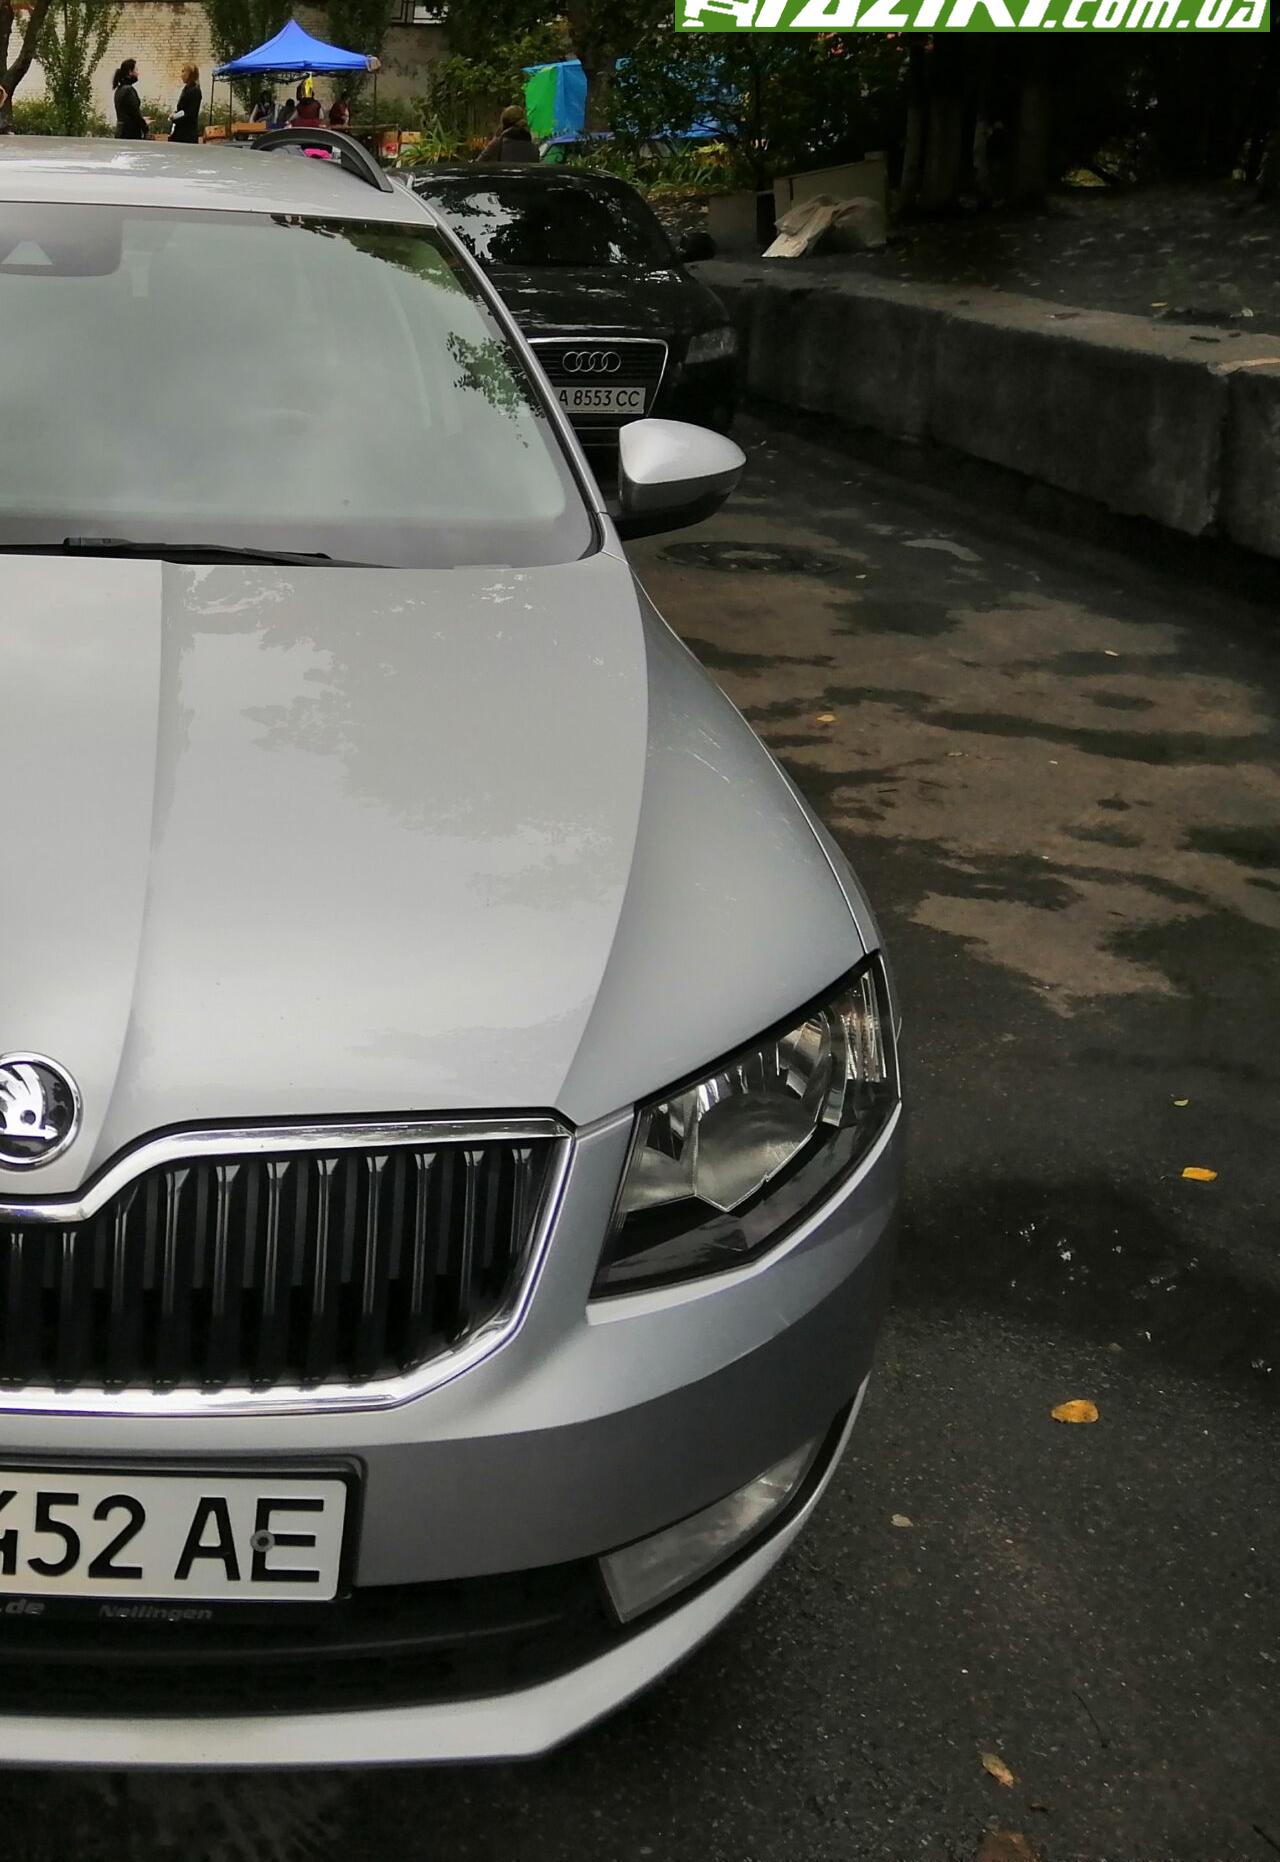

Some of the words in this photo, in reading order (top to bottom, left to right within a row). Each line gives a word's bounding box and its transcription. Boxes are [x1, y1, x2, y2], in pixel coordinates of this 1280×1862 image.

[558, 389, 569, 406] A
[573, 389, 613, 407] 8553
[616, 390, 640, 407] CC
[173, 1496, 325, 1584] AE
